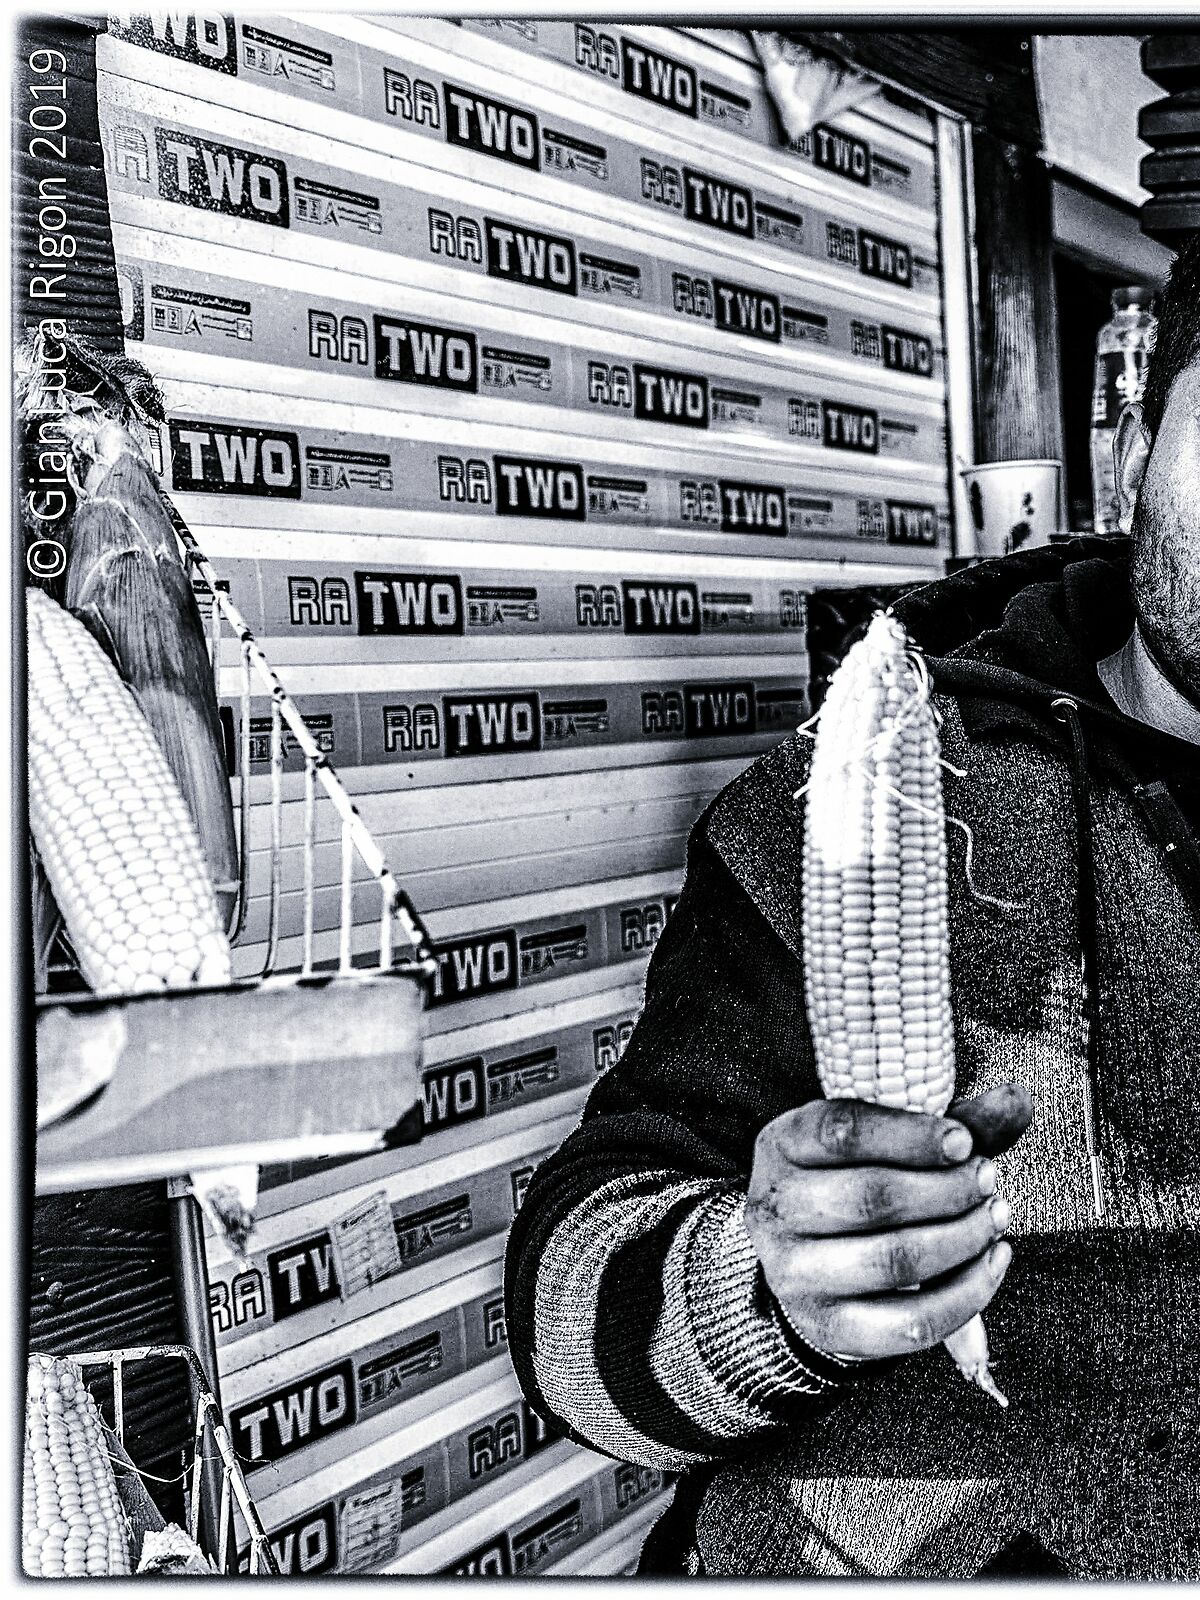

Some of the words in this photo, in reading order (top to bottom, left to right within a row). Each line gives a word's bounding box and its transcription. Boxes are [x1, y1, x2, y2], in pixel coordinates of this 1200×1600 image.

[626, 46, 692, 108] TWO
[383, 67, 440, 129] RA
[449, 92, 535, 160] TWO
[165, 139, 281, 214] TWO
[816, 128, 866, 177] TWO
[688, 176, 749, 229] TWO
[428, 207, 482, 263] RA
[491, 226, 573, 286] TWO
[862, 236, 909, 281] TWO
[718, 287, 776, 334] TWO
[308, 308, 369, 365] RA
[380, 325, 473, 383] TWO
[886, 333, 931, 372] TWO
[588, 360, 632, 408] RA
[639, 373, 704, 423] TWO
[826, 408, 875, 447] TWO
[179, 429, 293, 487] TWO
[438, 455, 492, 504] RA
[500, 464, 579, 510] TWO
[726, 490, 783, 527] TWO
[890, 506, 934, 540] TWO
[288, 576, 352, 625] RA
[363, 580, 457, 626] TWO
[575, 584, 622, 626] RA
[627, 587, 695, 625] TWO
[383, 704, 440, 752] RA
[450, 701, 533, 747] TWO
[691, 692, 748, 728] TWO
[432, 941, 509, 997] TWO
[421, 1070, 477, 1124] WO
[239, 1373, 346, 1460] TWO
[468, 1412, 523, 1479] RA
